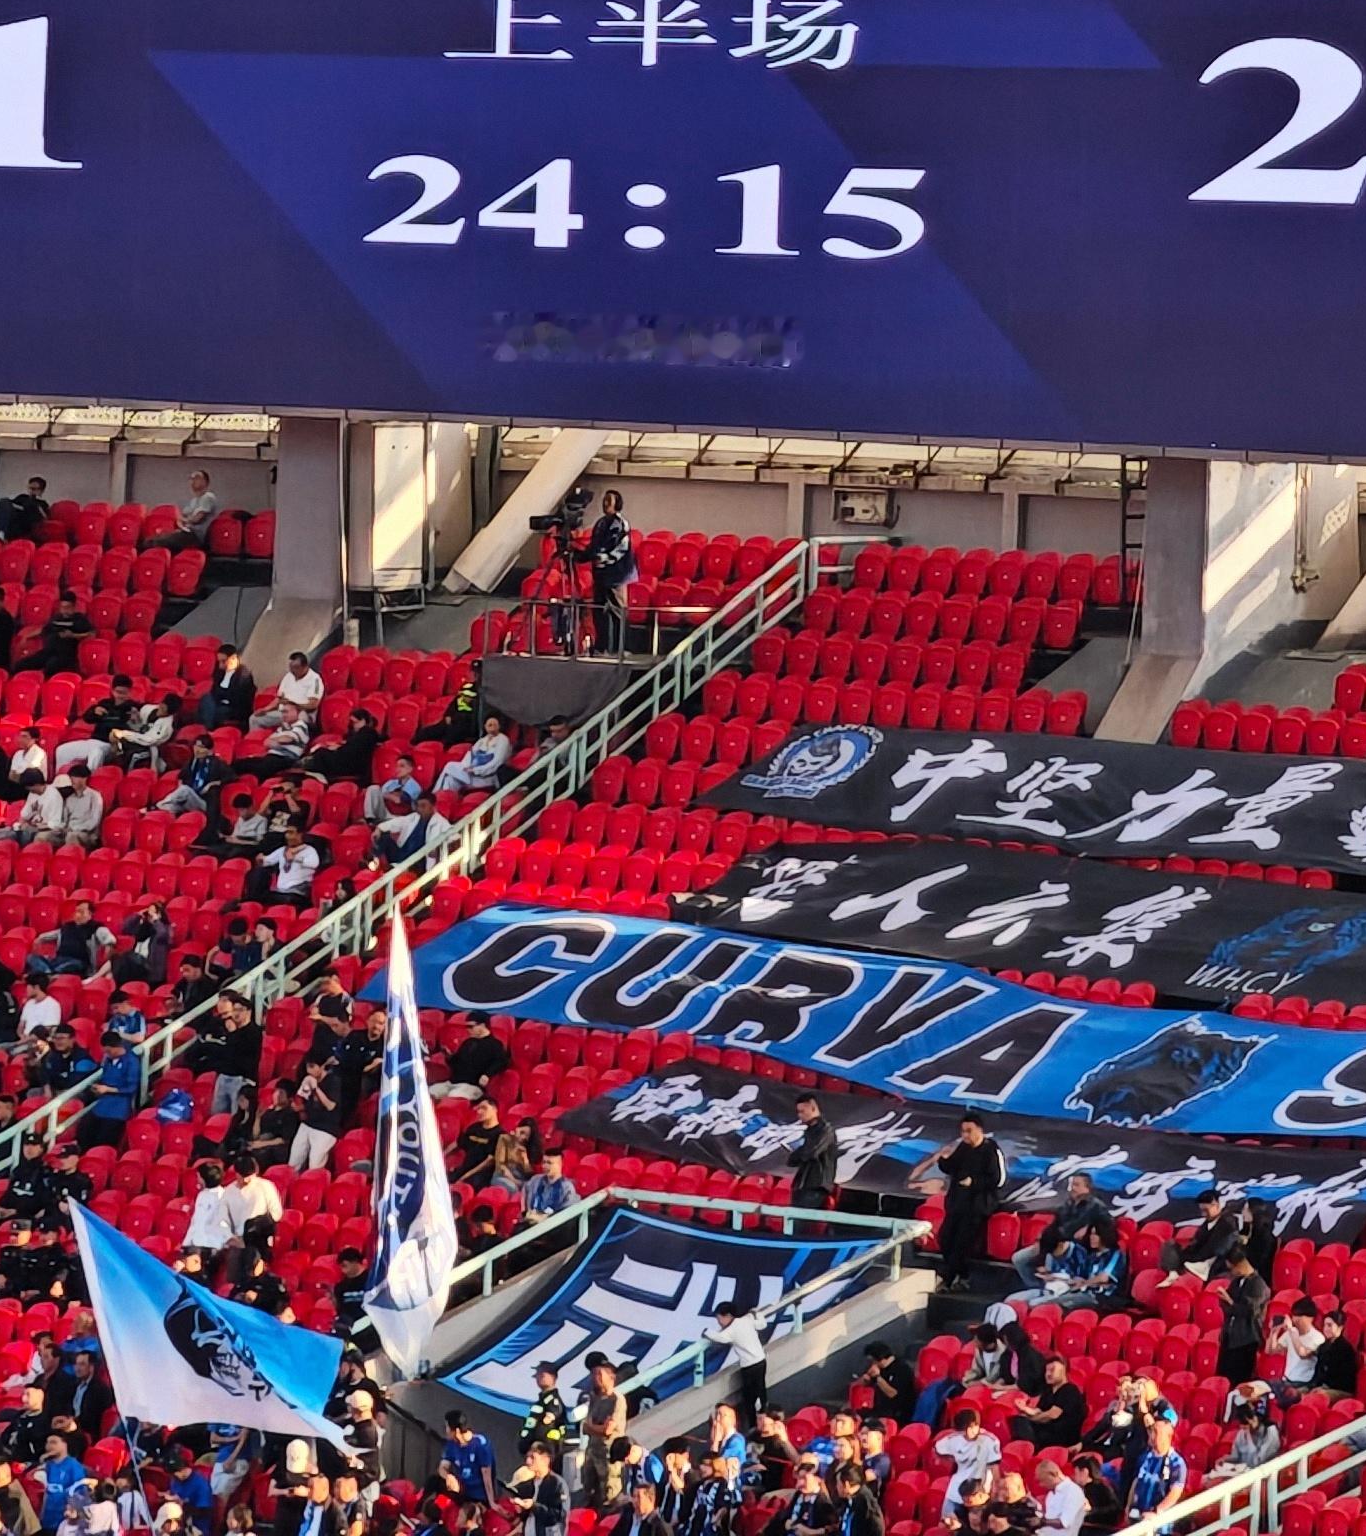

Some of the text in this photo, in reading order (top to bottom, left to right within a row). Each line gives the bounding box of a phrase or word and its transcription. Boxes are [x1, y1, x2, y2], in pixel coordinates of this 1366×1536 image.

[361, 153, 927, 261] 24:15
[888, 738, 1343, 851] 中坚力量
[443, 914, 1087, 1105] CURVA
